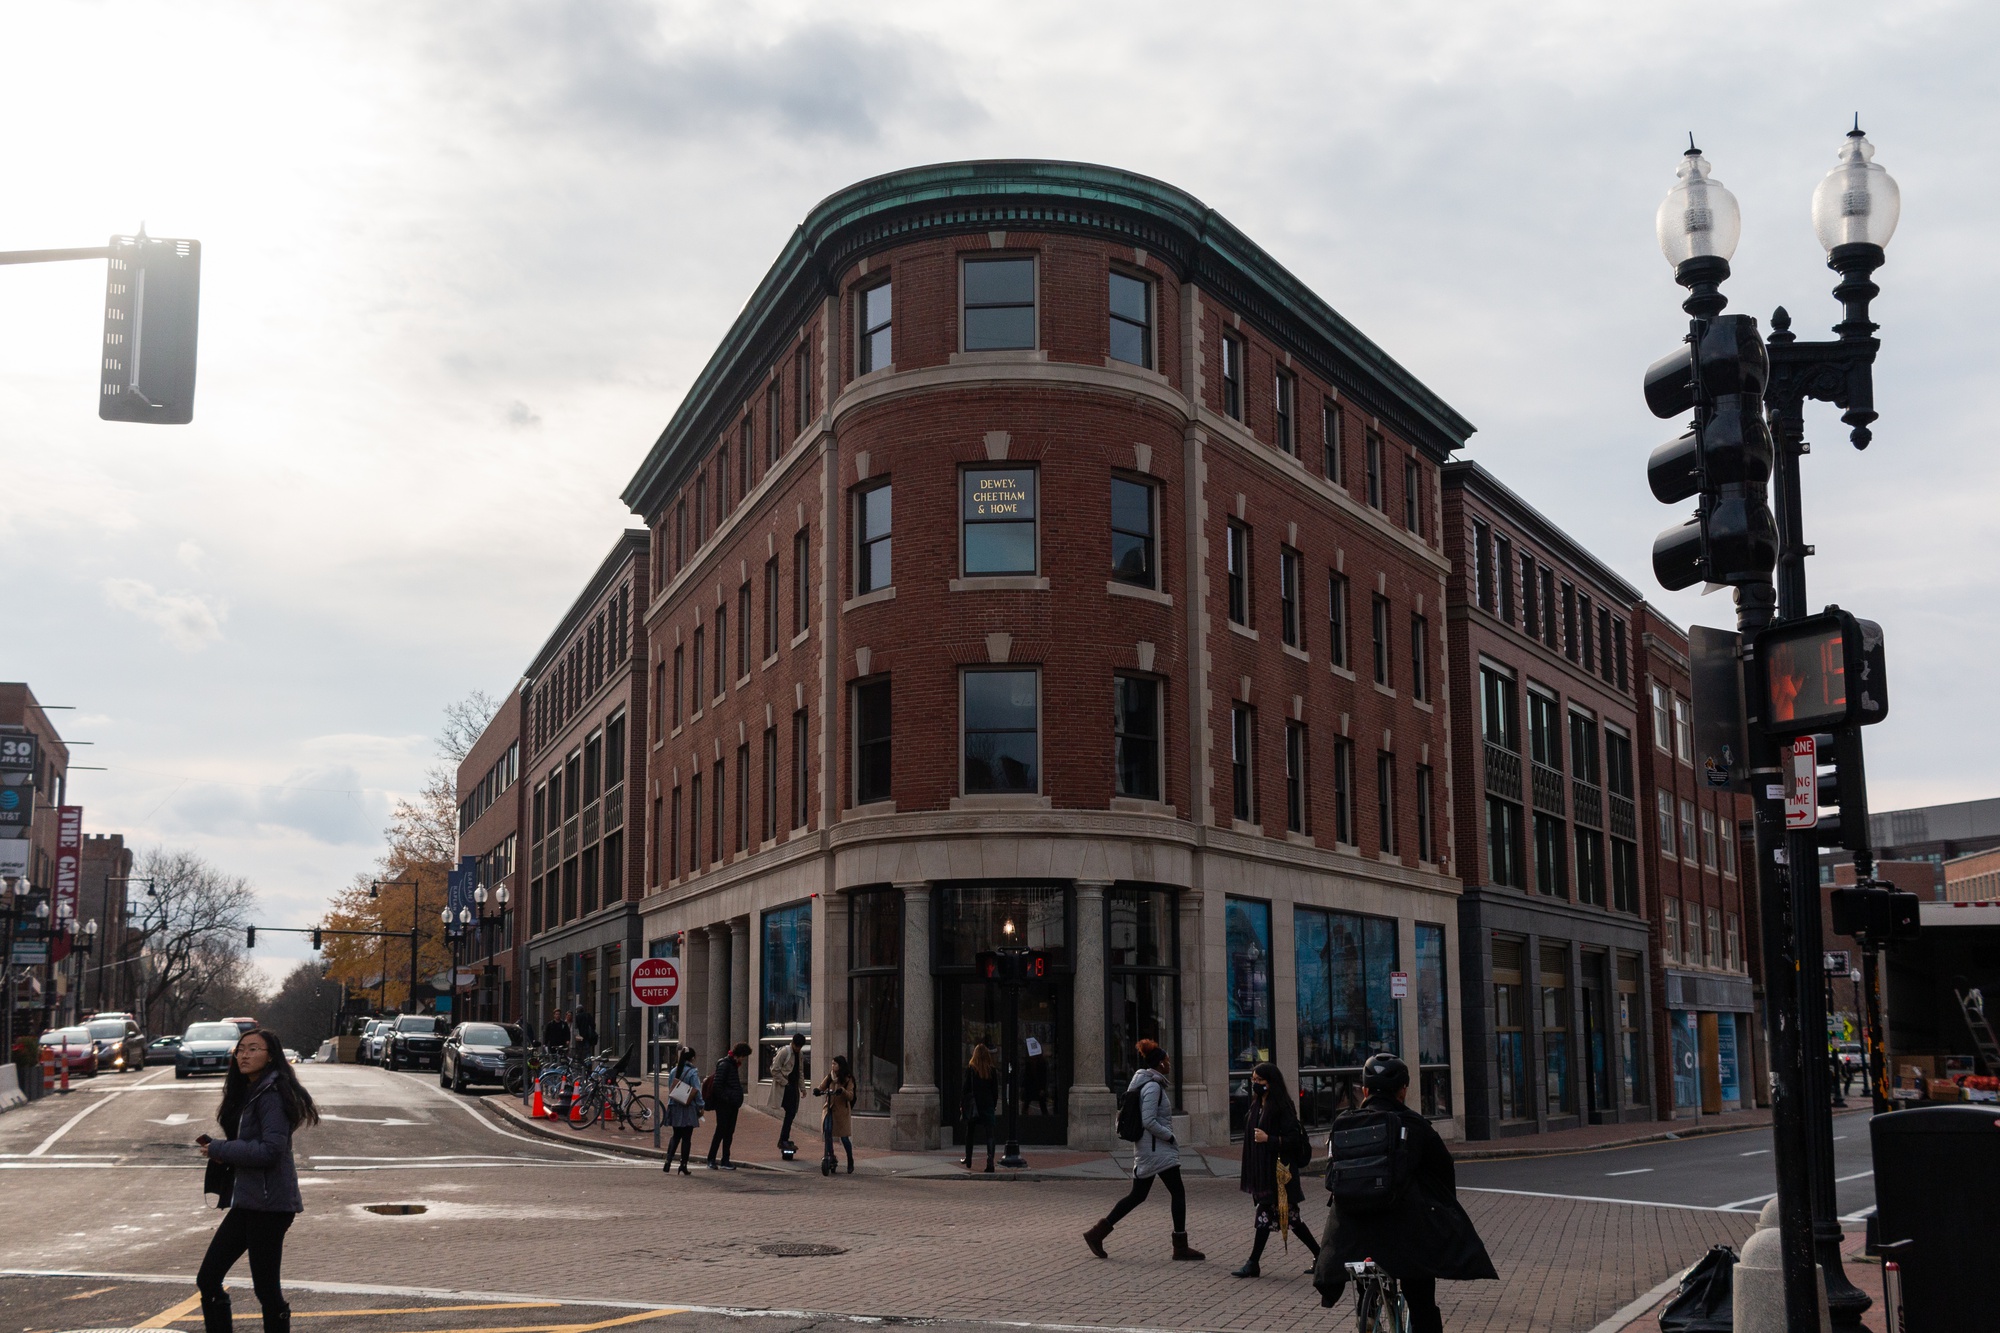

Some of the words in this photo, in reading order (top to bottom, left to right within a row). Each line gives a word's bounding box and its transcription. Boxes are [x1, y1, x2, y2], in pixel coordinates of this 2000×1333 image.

[980, 479, 1016, 489] DEWEY,
[973, 491, 1025, 502] CHEETHAM
[978, 504, 985, 514] &
[990, 503, 1018, 514] HOWE
[3, 741, 31, 756] 30
[1793, 740, 1813, 754] ONE
[1, 755, 17, 763] JFK
[60, 809, 80, 848] THE
[638, 968, 650, 976] DO
[655, 967, 672, 976] NOT
[642, 988, 669, 997] ENTER
